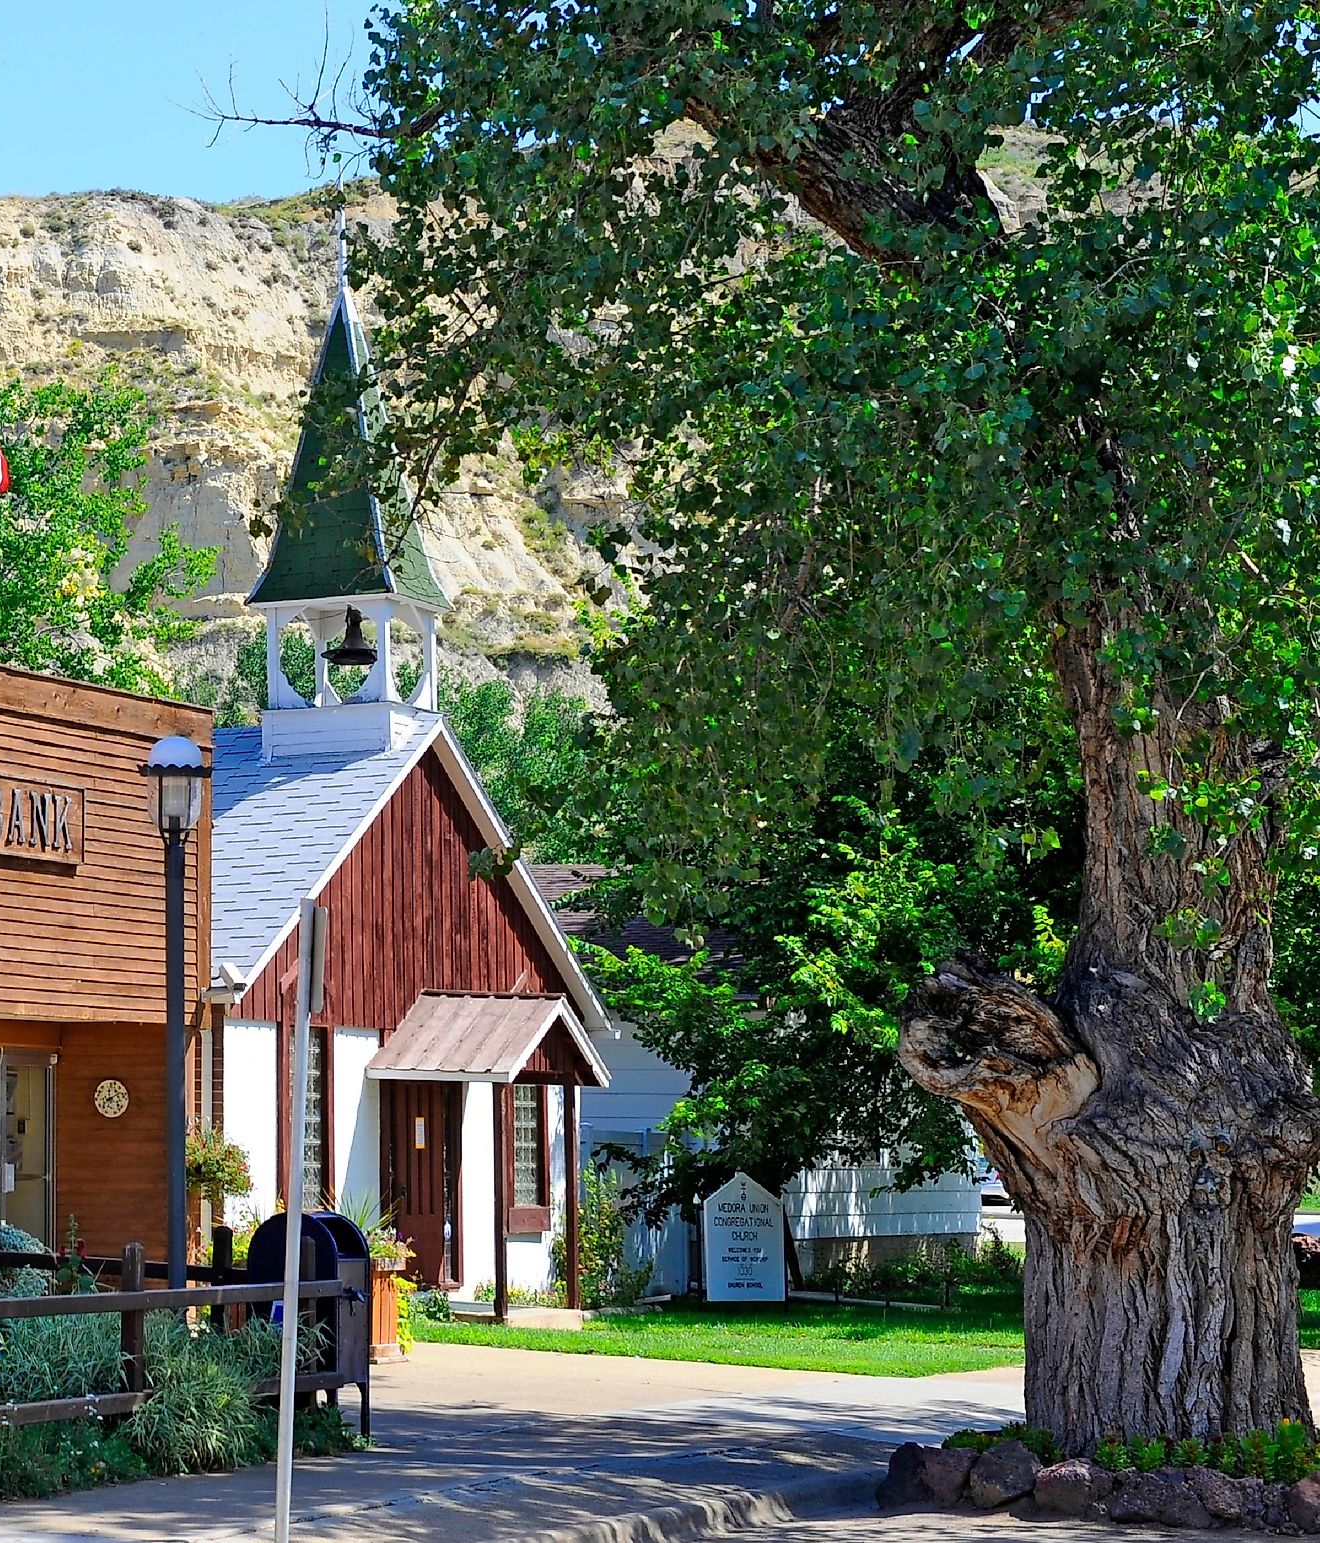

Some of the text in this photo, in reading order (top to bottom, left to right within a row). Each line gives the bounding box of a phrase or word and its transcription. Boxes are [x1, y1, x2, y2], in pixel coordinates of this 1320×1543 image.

[717, 1202, 769, 1213] MEDORA UNION
[713, 1216, 774, 1228] CONGREGATIONAL
[732, 1231, 758, 1241] CHURCH
